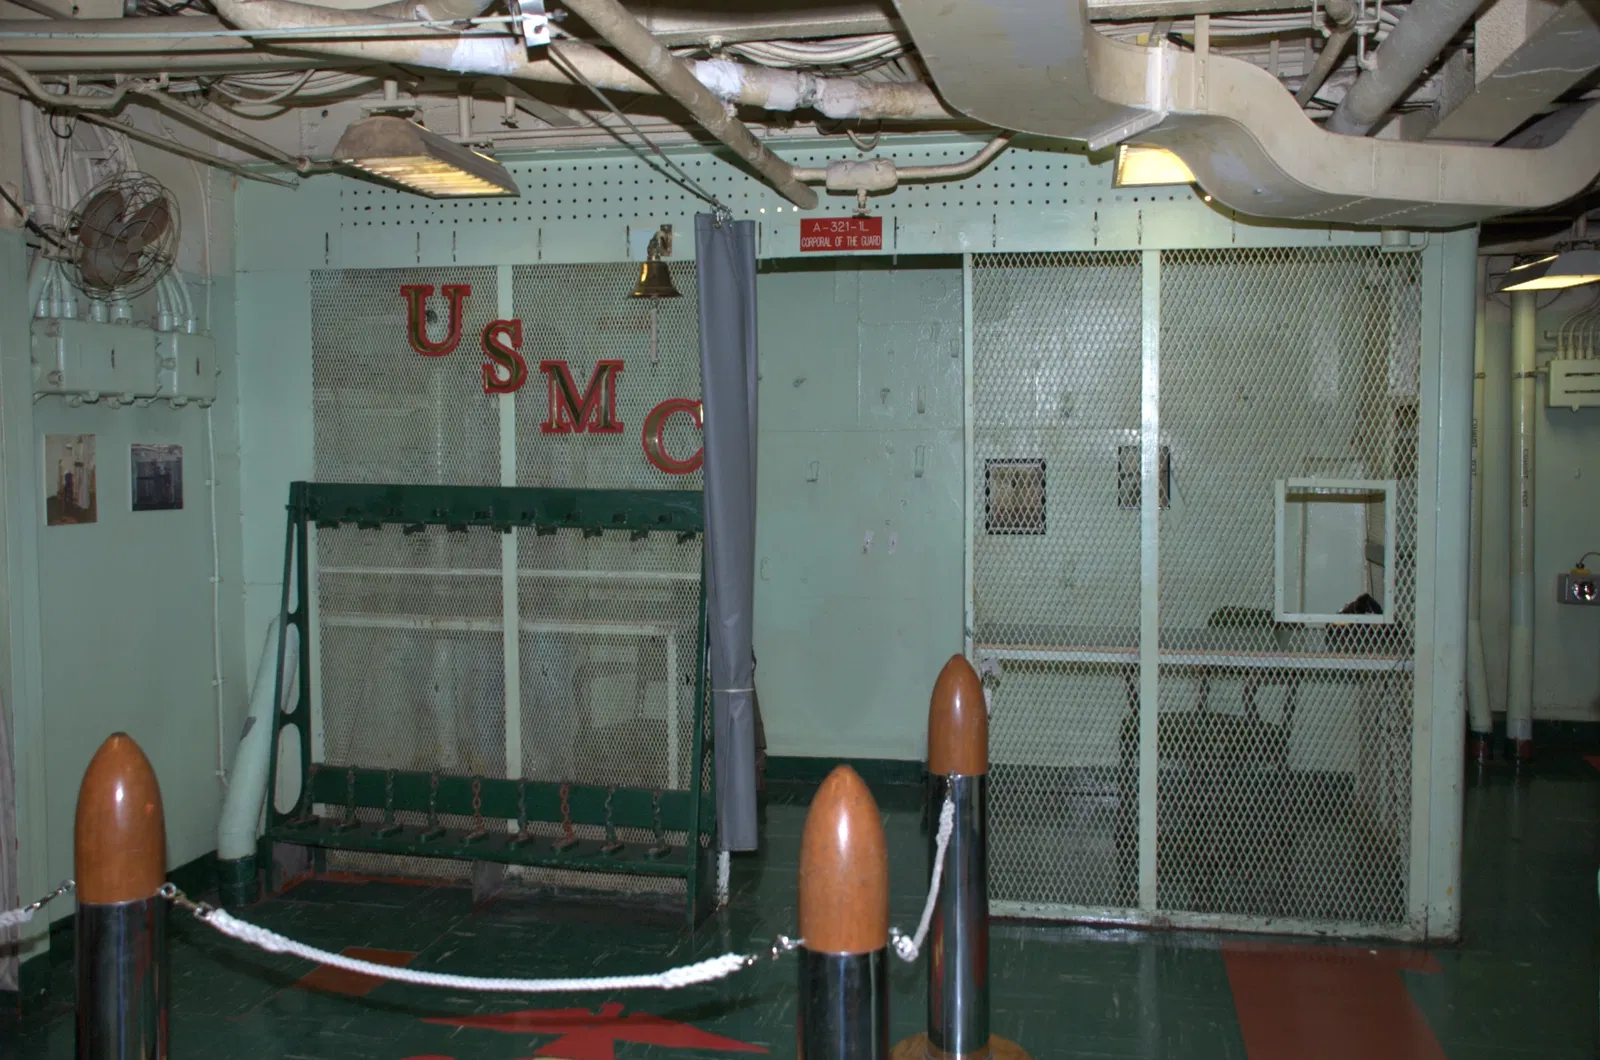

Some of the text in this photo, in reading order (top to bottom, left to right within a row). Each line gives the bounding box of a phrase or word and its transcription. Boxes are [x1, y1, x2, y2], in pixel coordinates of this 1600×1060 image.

[801, 235, 881, 248] CORPORAL OF THE GUARD
